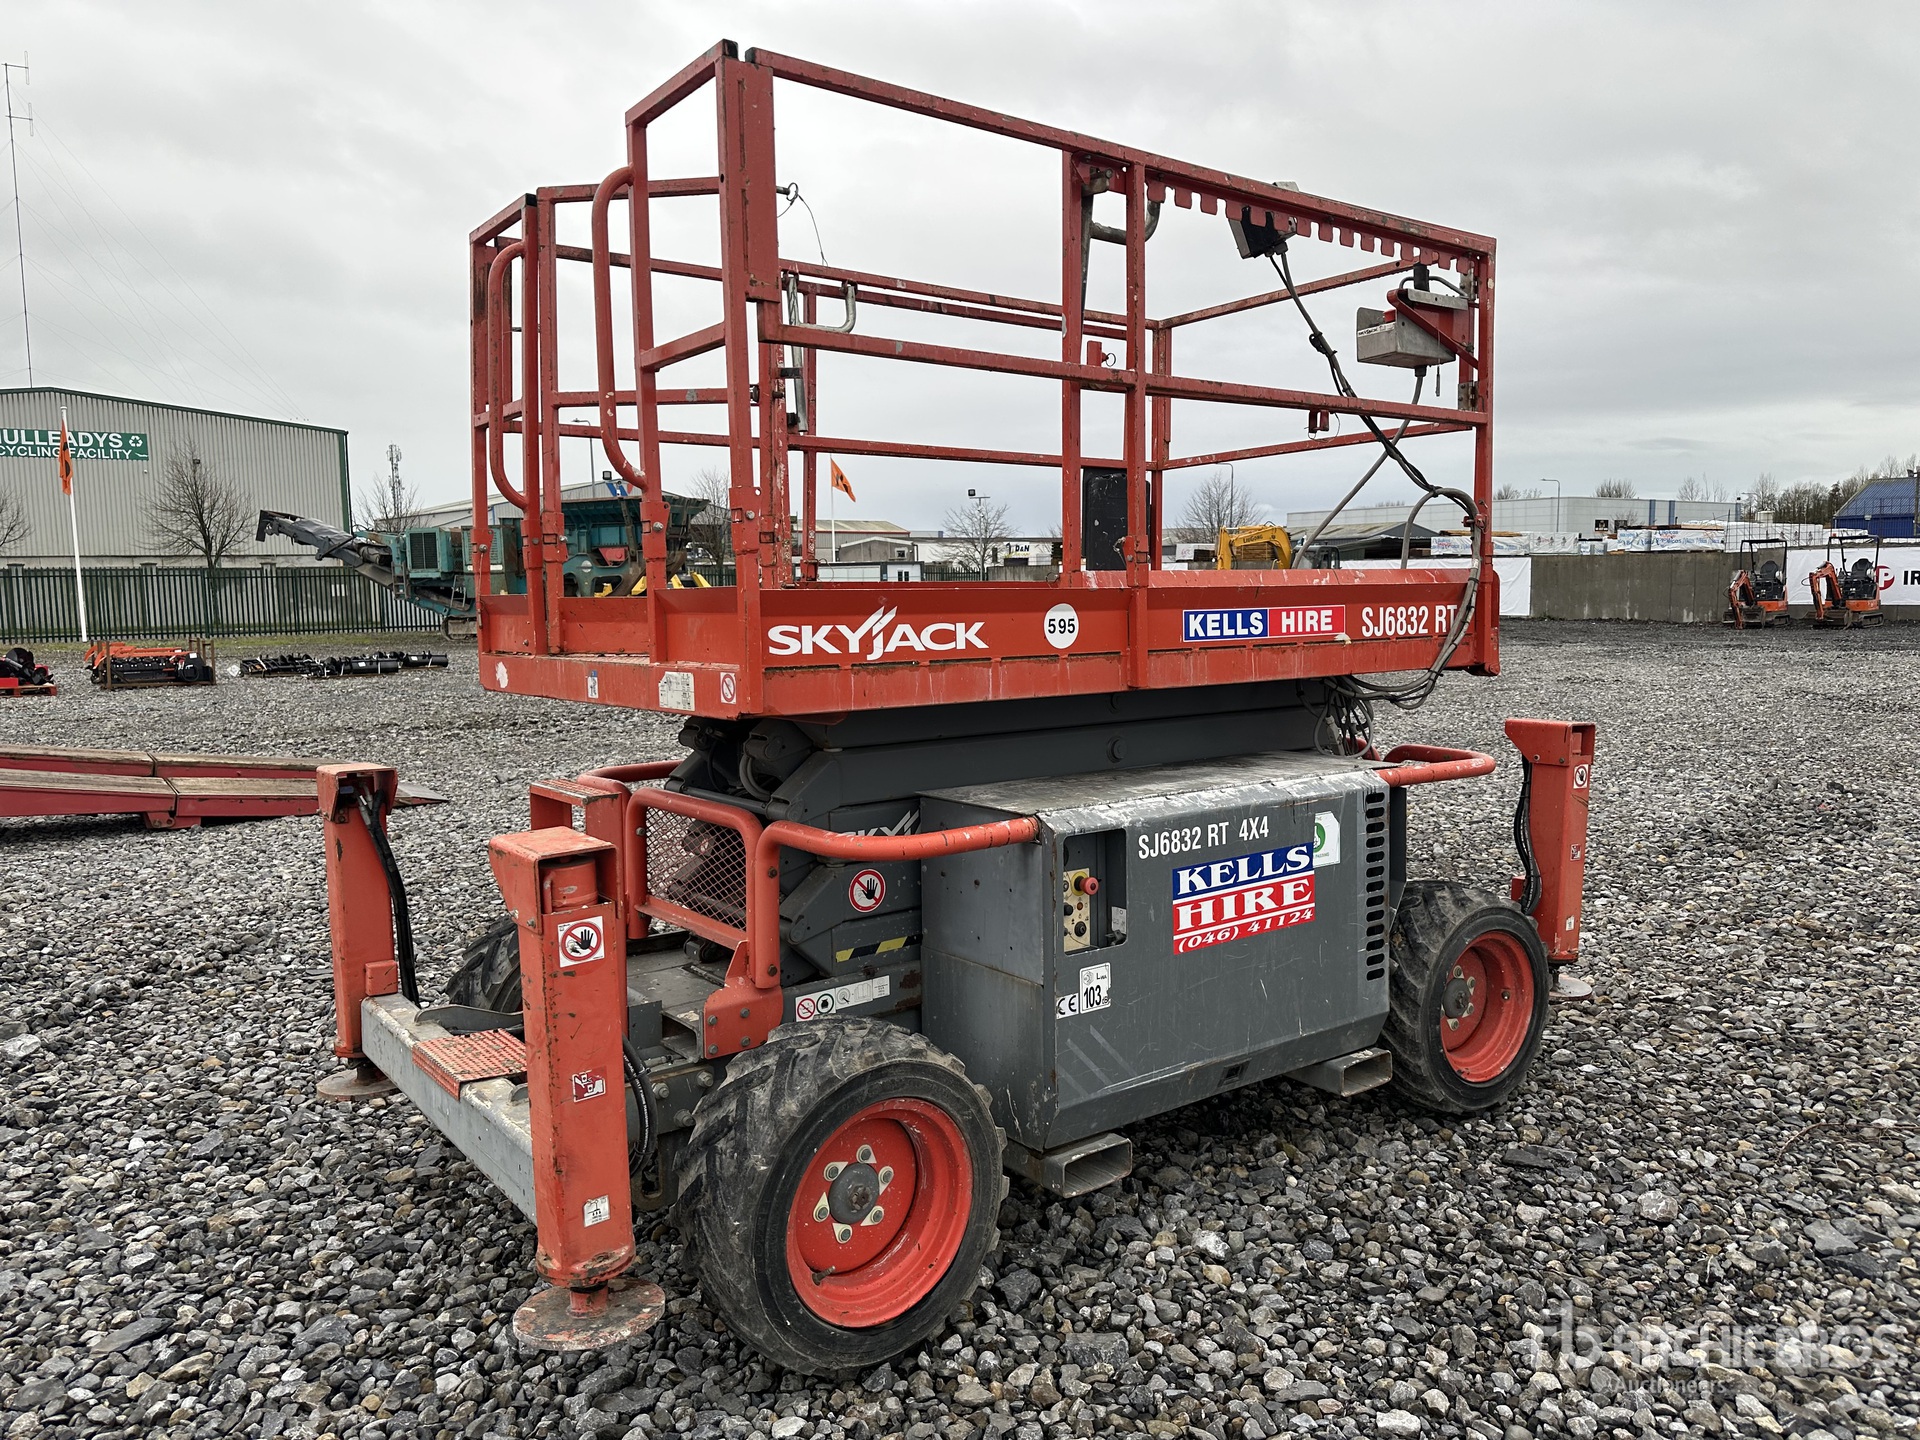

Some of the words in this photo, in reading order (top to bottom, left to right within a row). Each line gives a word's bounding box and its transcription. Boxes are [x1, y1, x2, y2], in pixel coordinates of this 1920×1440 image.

[0, 429, 123, 448] ULLEADYS
[68, 448, 132, 459] FACILITY
[768, 605, 990, 661] SKYJACK
[1047, 618, 1076, 635] 595
[1188, 612, 1264, 638] KELLS
[1281, 609, 1333, 633] HIRE
[1361, 605, 1428, 637] SJ6832
[1435, 604, 1458, 633] RT
[1138, 826, 1202, 859] SJ6832
[1207, 821, 1230, 848] RT
[1239, 815, 1269, 841] 4X4
[1176, 845, 1311, 896] KELLS
[1176, 878, 1313, 931] HIRE
[1178, 926, 1239, 953] (046)
[1247, 908, 1314, 933] 41124
[1083, 984, 1102, 1009] 103
